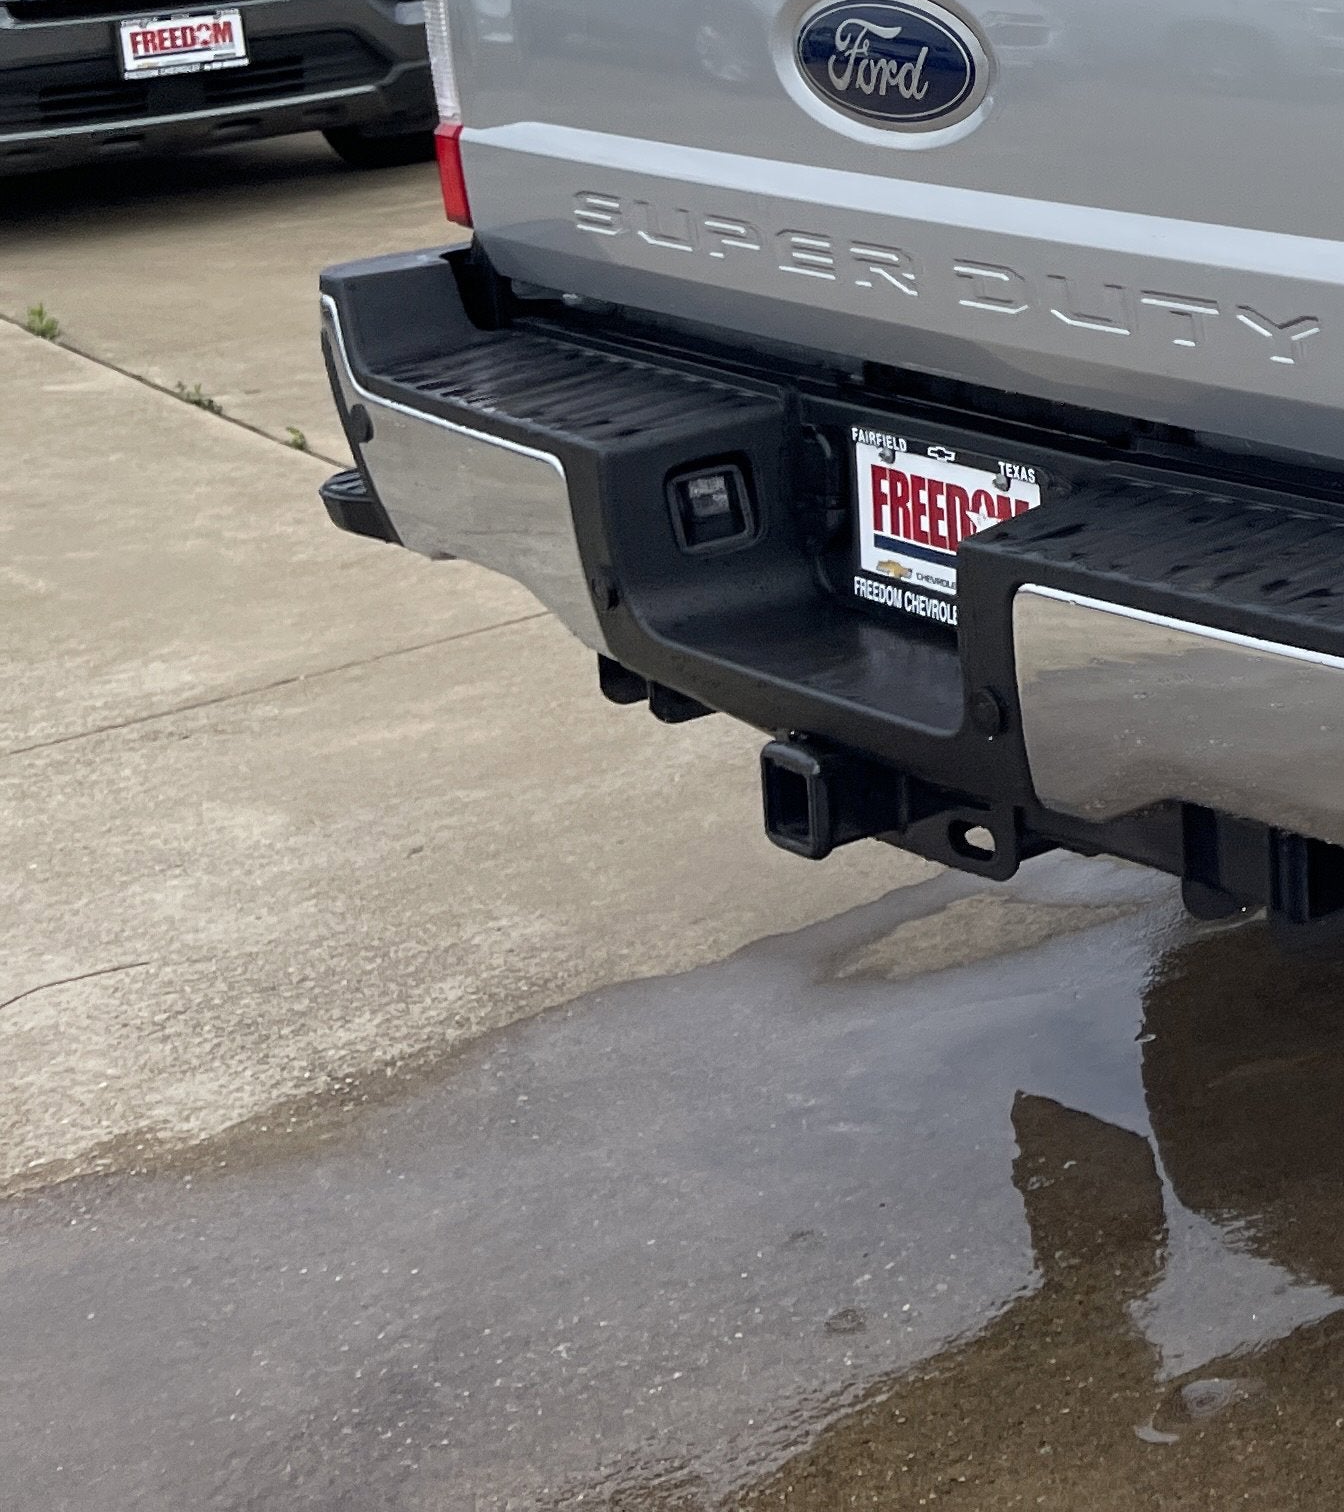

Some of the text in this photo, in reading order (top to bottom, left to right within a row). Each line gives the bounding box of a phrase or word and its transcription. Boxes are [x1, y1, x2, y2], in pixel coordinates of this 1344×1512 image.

[129, 21, 234, 55] FREEDOM
[828, 18, 929, 100] Ford
[574, 190, 1321, 365] SUPER DUTY
[851, 427, 907, 452] FAIRFIELD
[998, 461, 1036, 484] TEXAS
[854, 576, 958, 626] FREEDOM CHEVROLE
